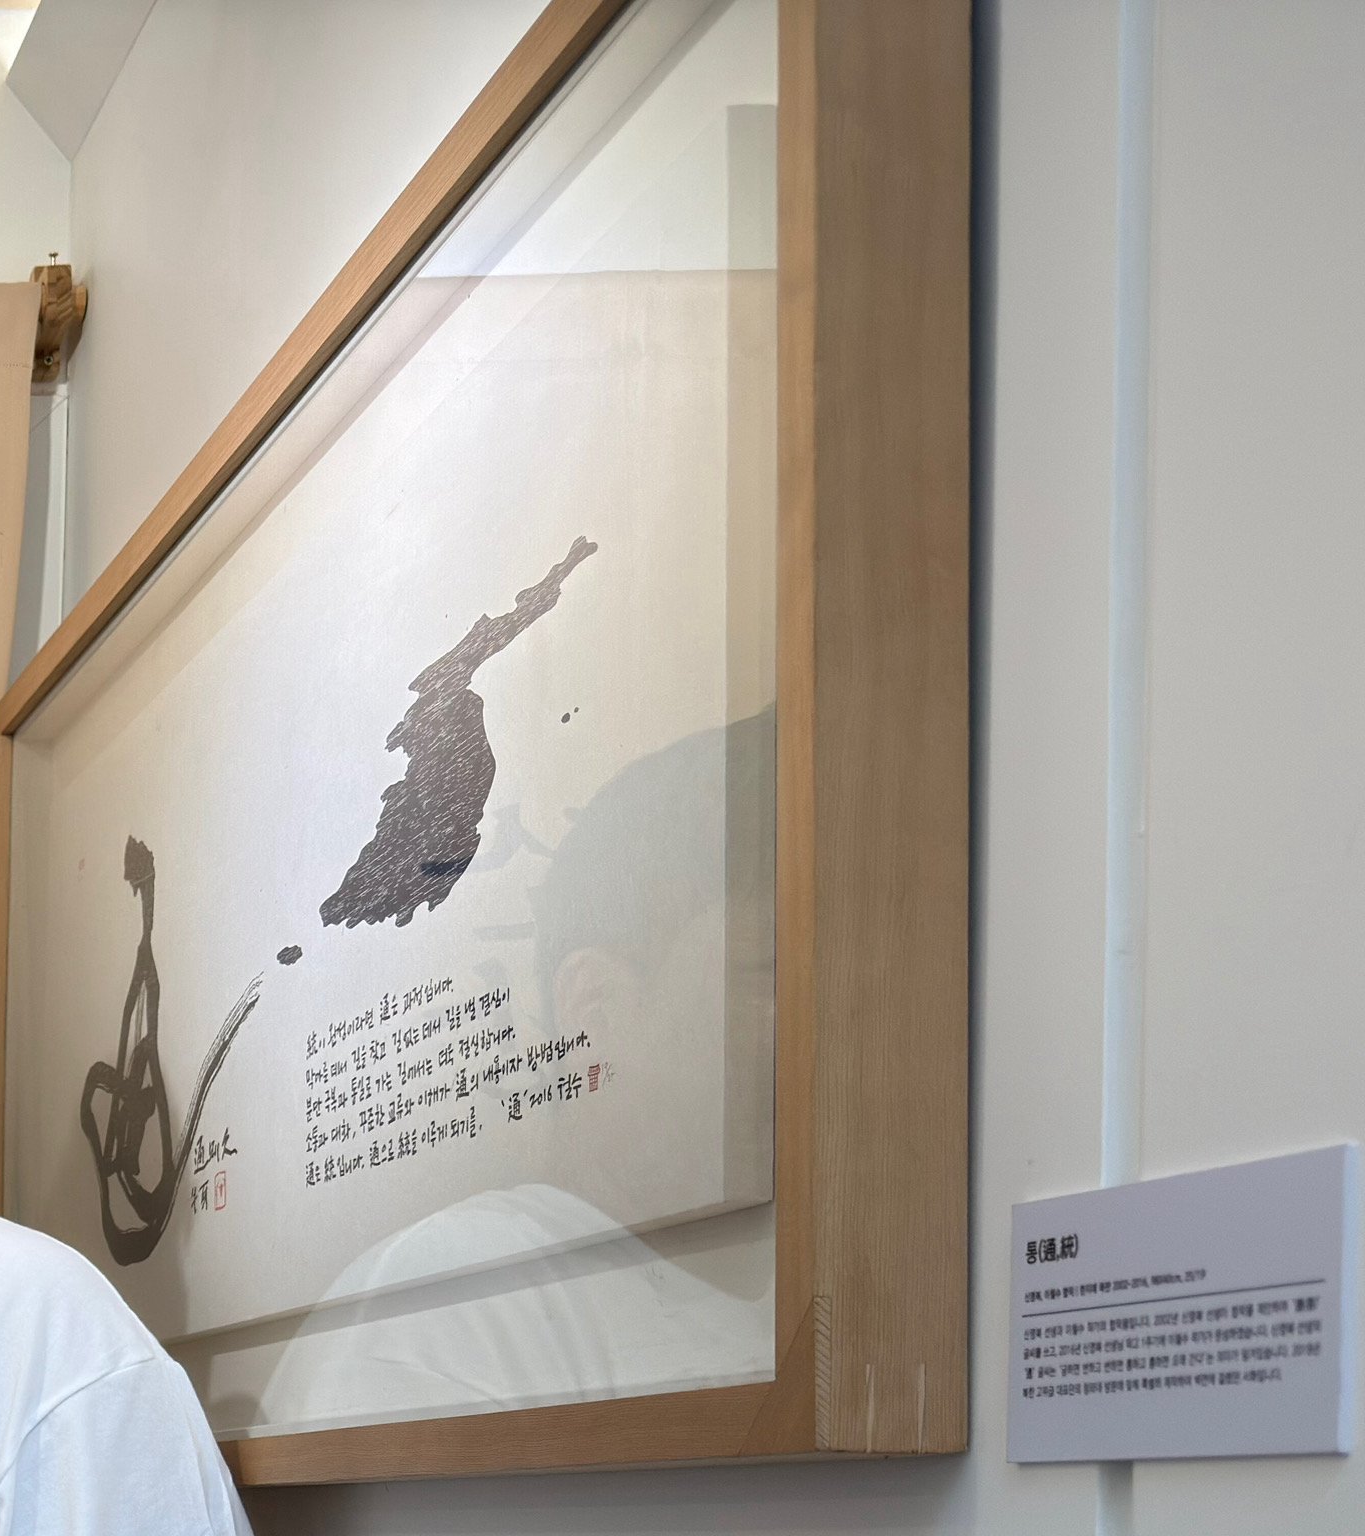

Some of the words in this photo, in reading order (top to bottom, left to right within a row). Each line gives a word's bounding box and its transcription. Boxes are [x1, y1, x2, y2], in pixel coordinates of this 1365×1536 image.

[526, 1030, 591, 1072] 방법입니다.
[529, 1084, 553, 1109] 2016
[557, 1072, 583, 1101] 철수
